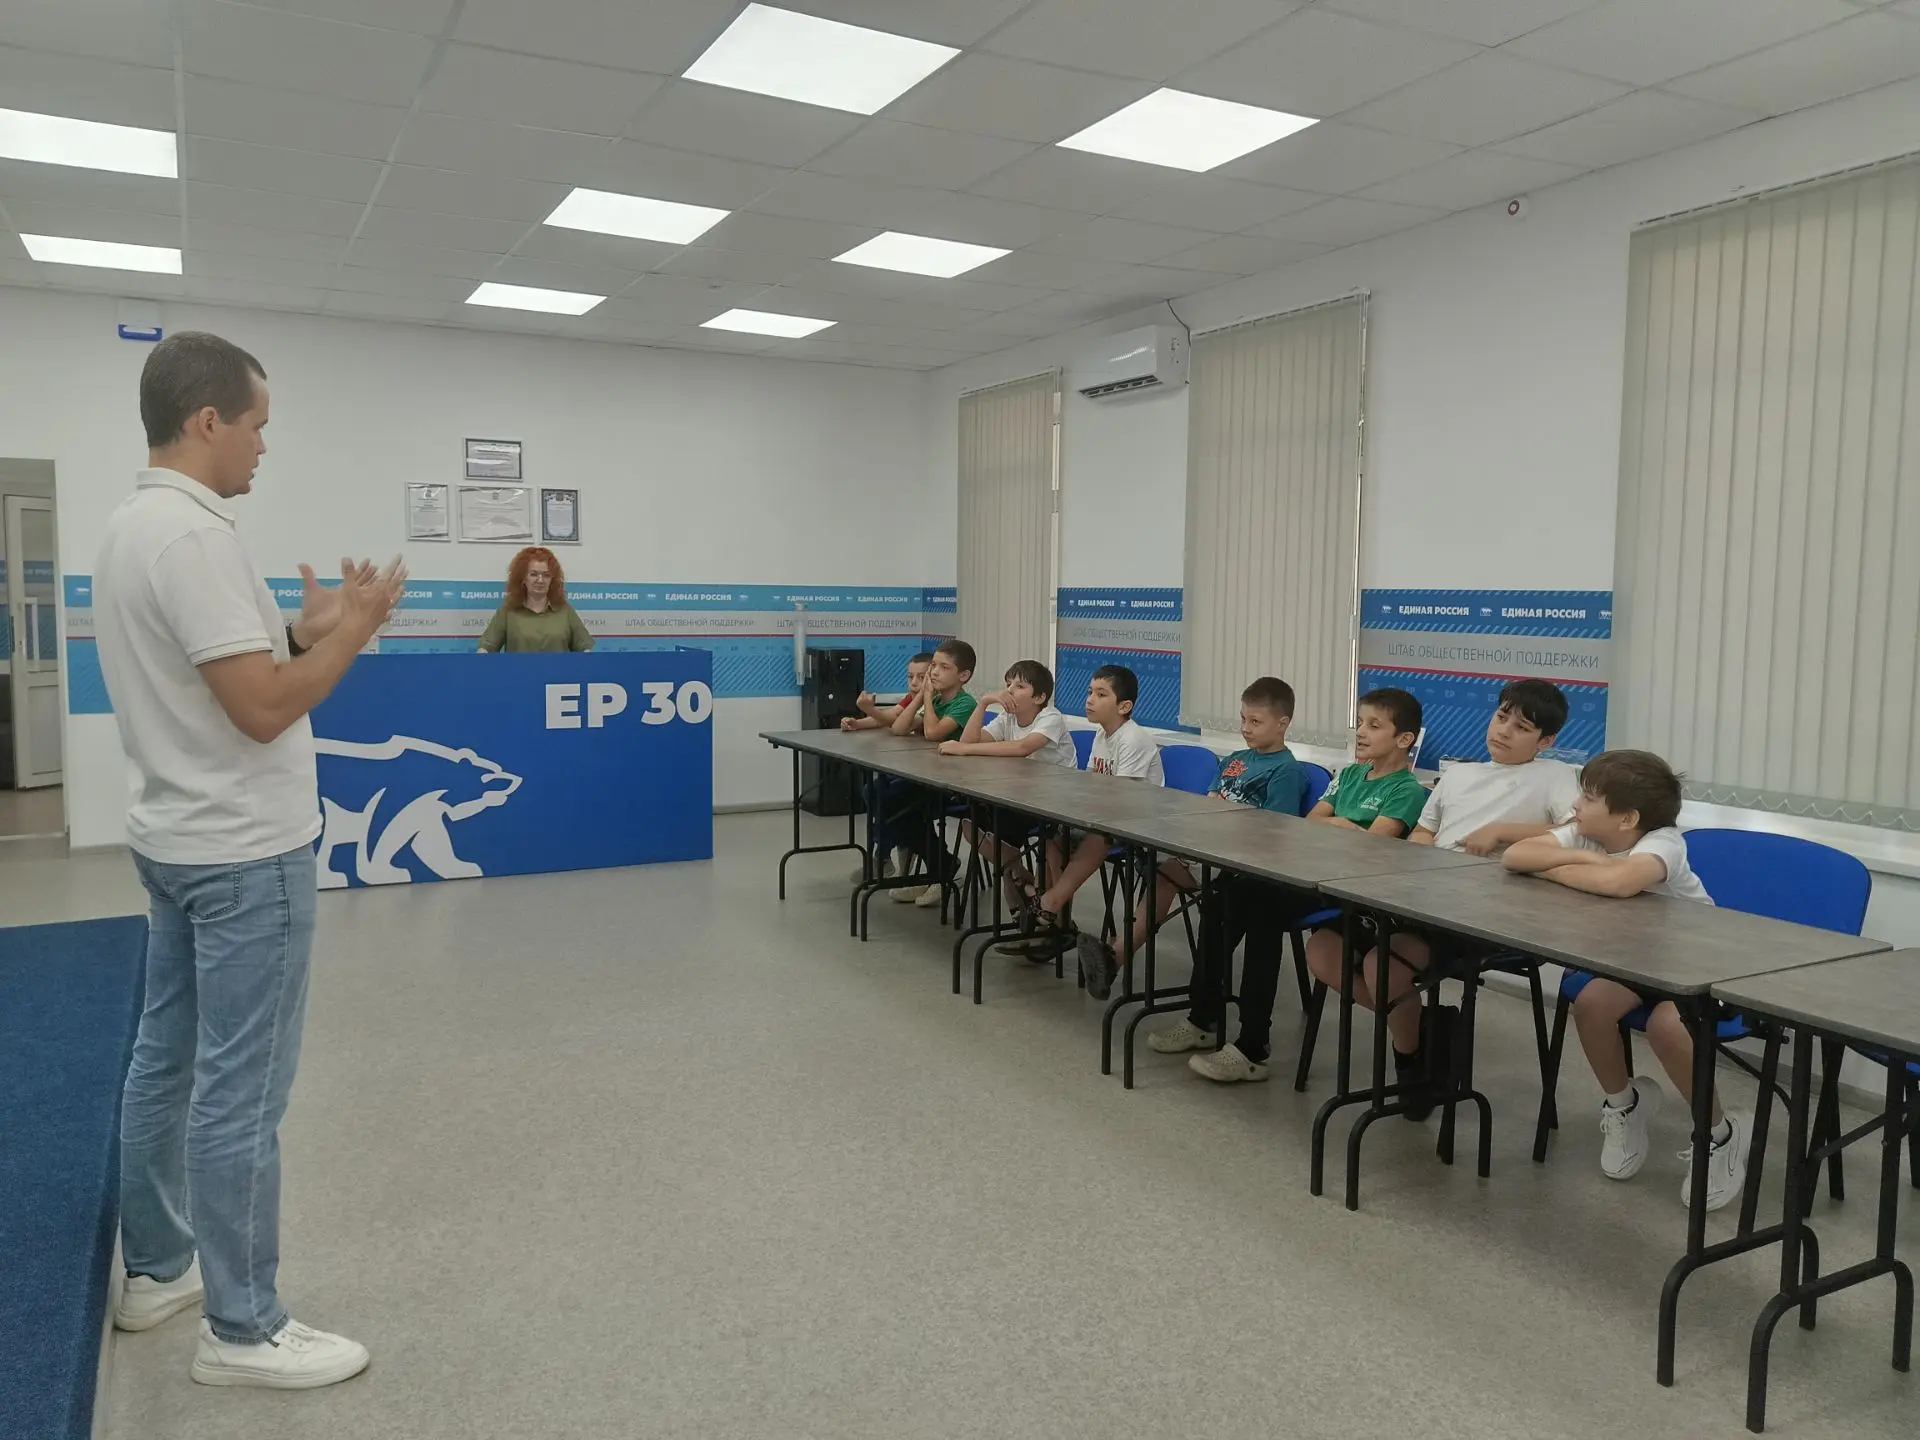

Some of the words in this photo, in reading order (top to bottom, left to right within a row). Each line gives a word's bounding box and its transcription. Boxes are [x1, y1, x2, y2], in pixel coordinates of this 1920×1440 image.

[278, 589, 304, 597] РОСС
[461, 591, 500, 599] ЕДИНАЯ
[567, 592, 603, 600] ЕДИНАЯ
[665, 593, 699, 601] ЕДИНАЯ
[1130, 600, 1152, 608] ЕДИНАЯ
[1398, 605, 1433, 616] ЕДИНАЯ
[1434, 606, 1470, 616] РОССИЯ
[1501, 607, 1543, 619] ЕДИНАЯ
[1544, 608, 1586, 619] РОССИЯ
[625, 619, 646, 627] ШТАБ
[648, 618, 708, 627] ОБЩЕСТВЕННОЙ
[776, 620, 795, 628] ШТА
[807, 618, 866, 628] БЩЕСТВЕННОЙ
[868, 619, 917, 629] ПОДДЕРЖКИ
[1388, 643, 1415, 657] ШТАБ
[1418, 645, 1512, 663] ОБЩЕСТВЕННОЙ
[1516, 651, 1599, 669] ПОДДЕРЖКИ
[545, 682, 628, 729] ЕР
[641, 680, 713, 725] 30
